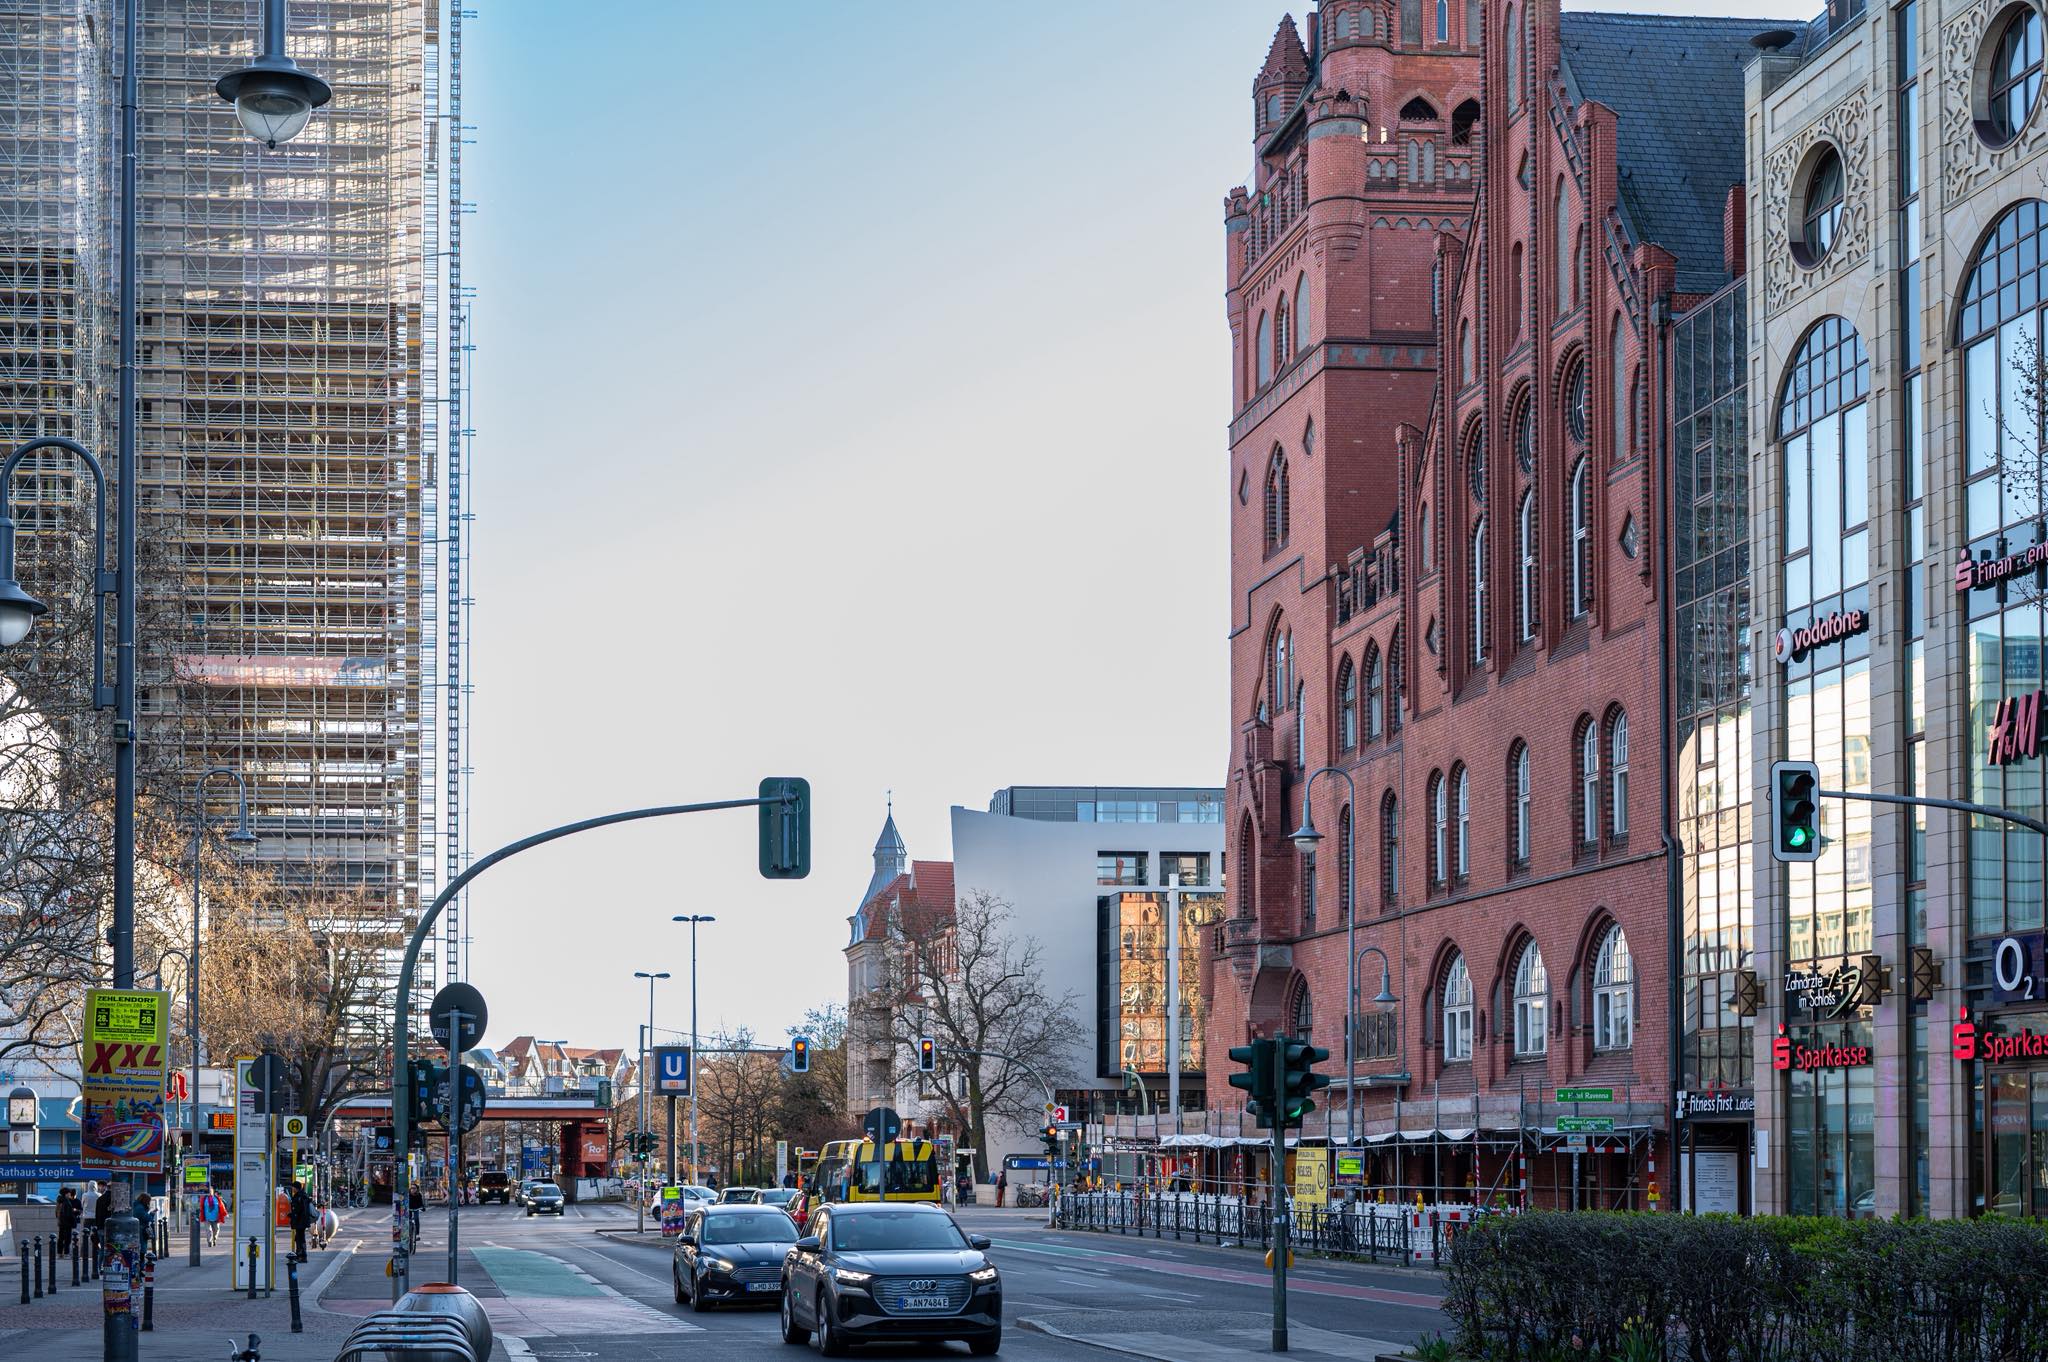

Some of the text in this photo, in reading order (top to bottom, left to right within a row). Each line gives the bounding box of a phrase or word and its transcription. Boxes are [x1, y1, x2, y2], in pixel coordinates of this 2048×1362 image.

[1794, 610, 1861, 652] vodafone
[1988, 688, 2040, 765] H&M
[1784, 973, 1823, 992] Zahnärzte
[97, 995, 157, 1003] ZEHLENDORF
[1798, 990, 1836, 1008] im Schloss
[88, 1043, 162, 1074] XXL
[665, 1055, 682, 1077] U
[1796, 1041, 1867, 1072] Sparkasse
[1689, 1094, 1715, 1114] fitness
[1716, 1093, 1733, 1114] first
[0, 1167, 74, 1179] Rathaus Steglitz
[120, 1160, 158, 1168] Outdoor
